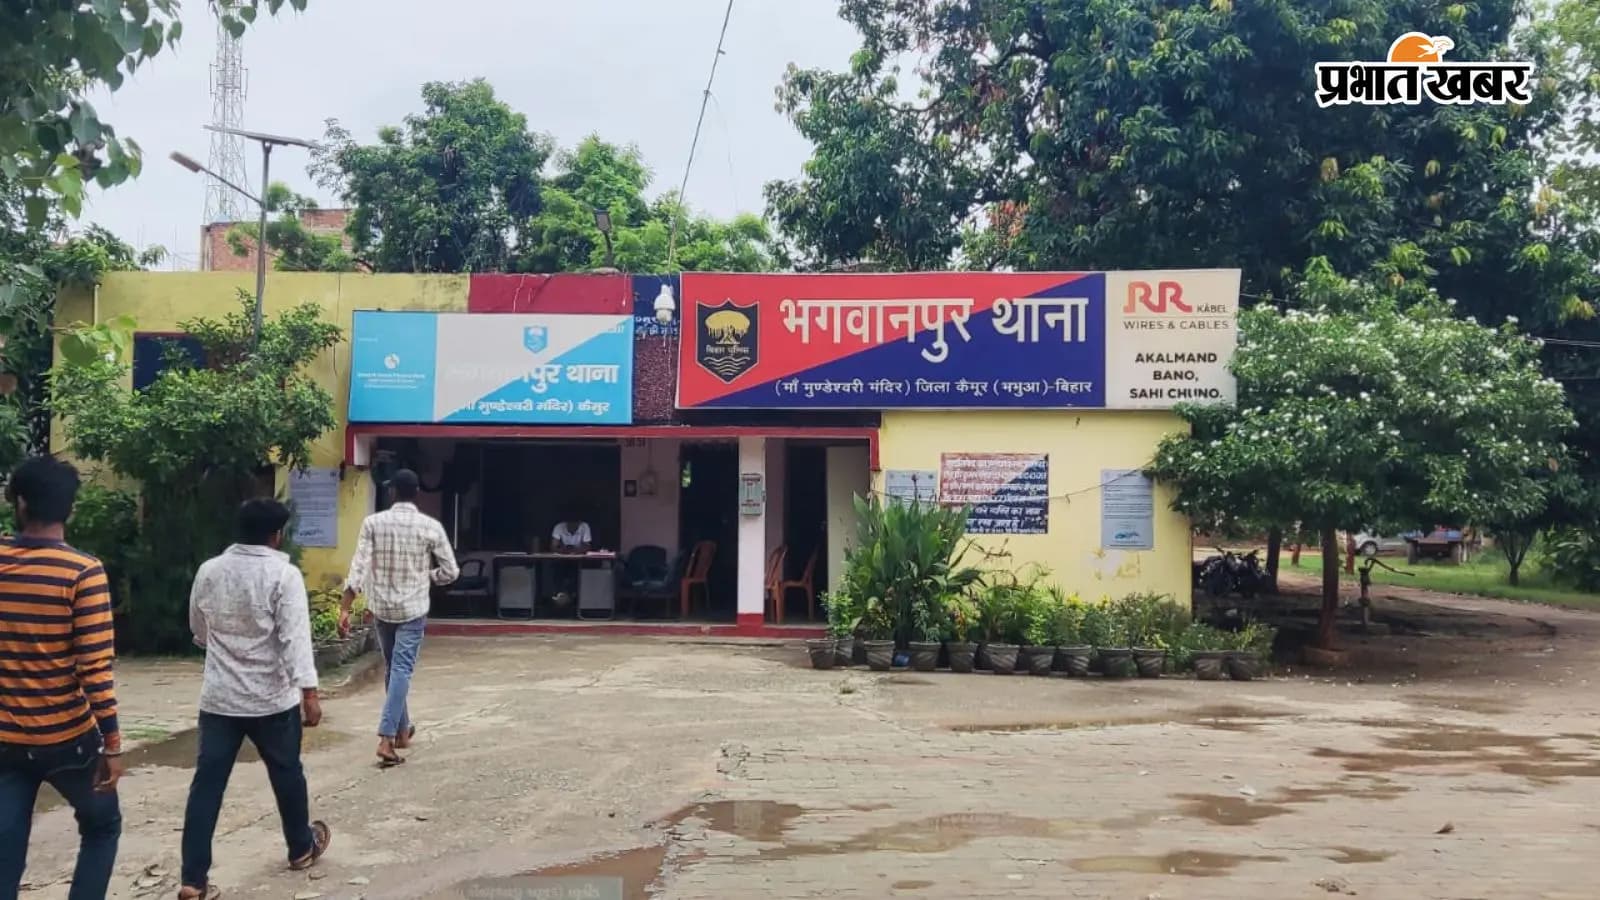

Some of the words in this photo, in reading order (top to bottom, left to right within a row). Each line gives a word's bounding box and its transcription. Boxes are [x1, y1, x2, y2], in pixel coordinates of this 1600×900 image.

[1123, 281, 1193, 314] RR
[779, 296, 975, 364] भगवानपुर
[992, 296, 1089, 344] थाना
[1124, 320, 1164, 330] WIRES
[1167, 320, 1176, 330] &
[1179, 320, 1230, 330] CABLES
[1135, 353, 1218, 363] AKALMAND
[566, 364, 620, 385] थाना
[1153, 370, 1200, 382] BANO,
[869, 378, 911, 396] मंदिर)
[916, 378, 950, 393] जिला
[956, 378, 990, 396] कैमूर
[1130, 388, 1163, 399] SAHI
